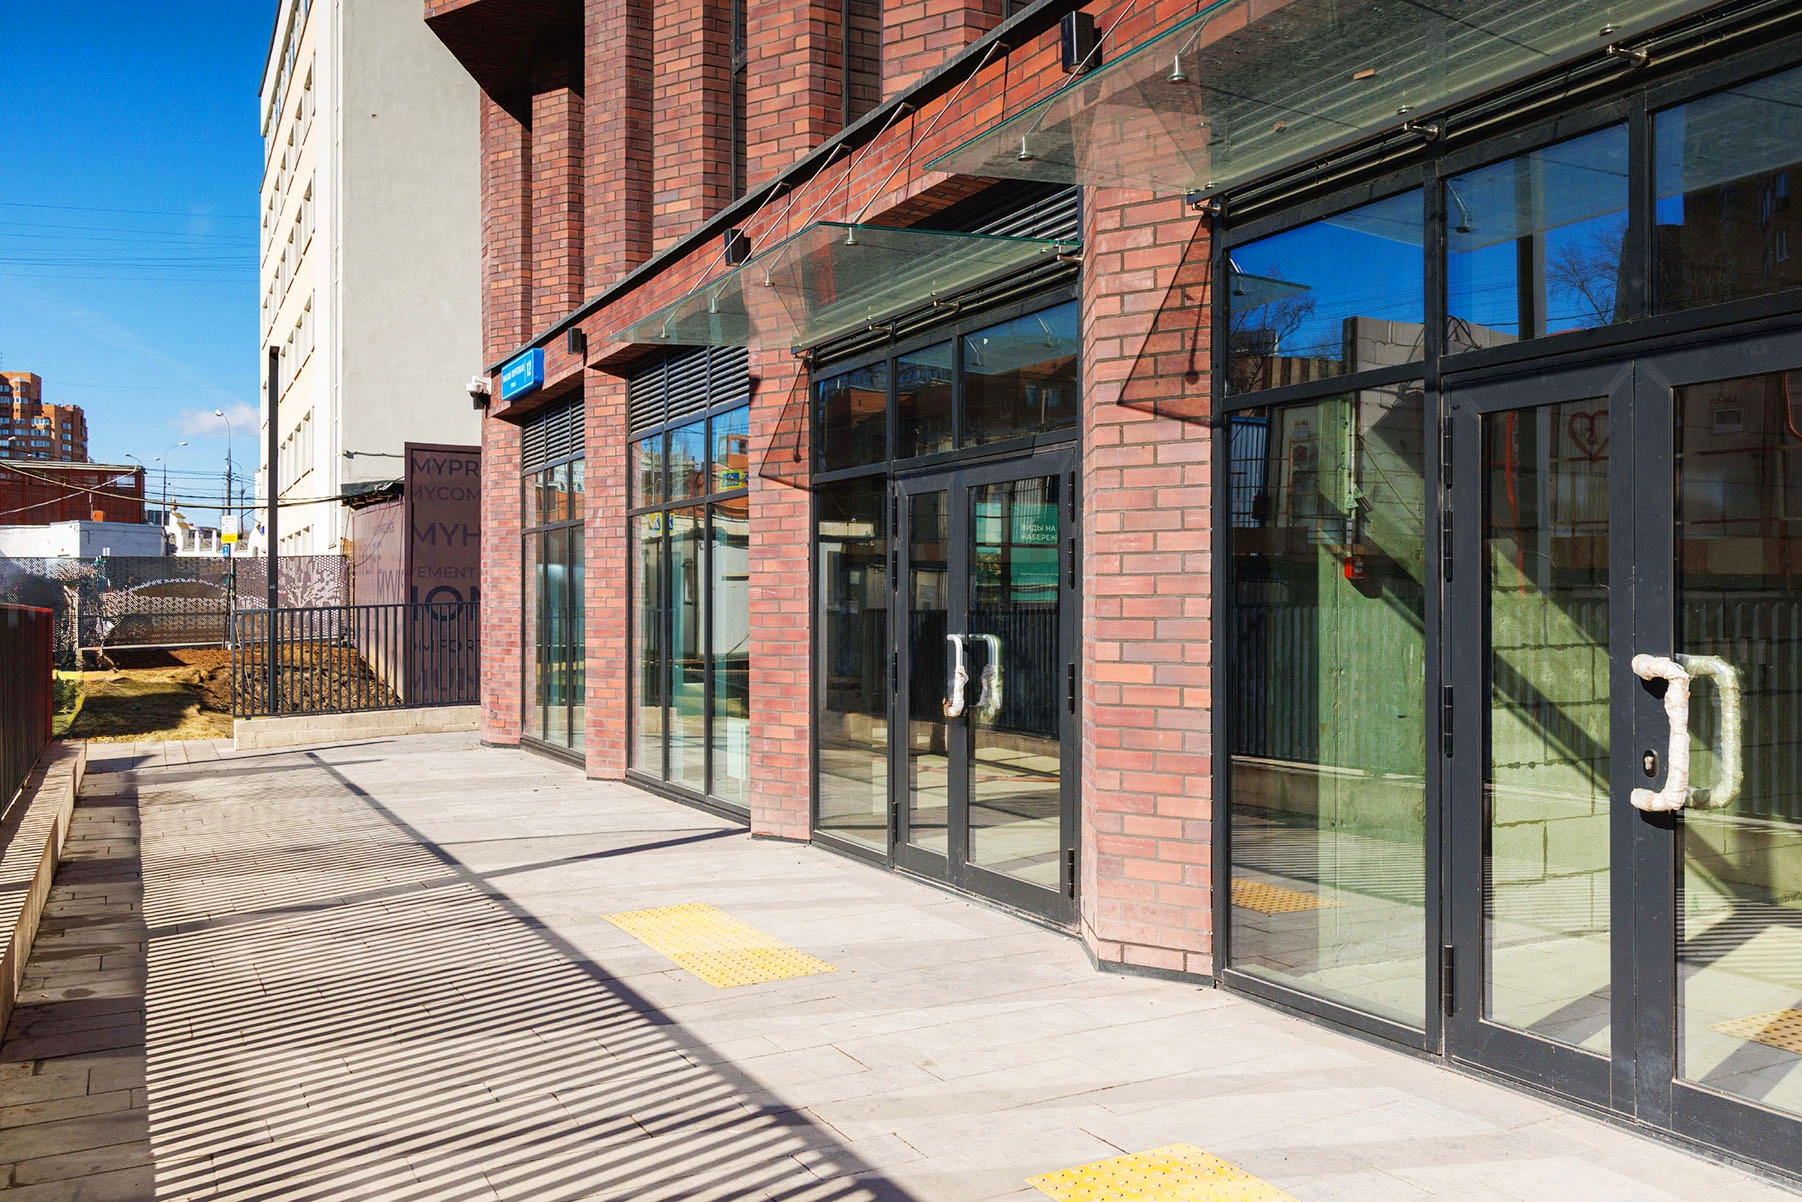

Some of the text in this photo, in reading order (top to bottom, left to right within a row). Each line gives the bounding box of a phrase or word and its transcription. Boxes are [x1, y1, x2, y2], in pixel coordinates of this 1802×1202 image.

[1021, 524, 1057, 532] ВИДЫ НА
[412, 566, 476, 579] EMENT
